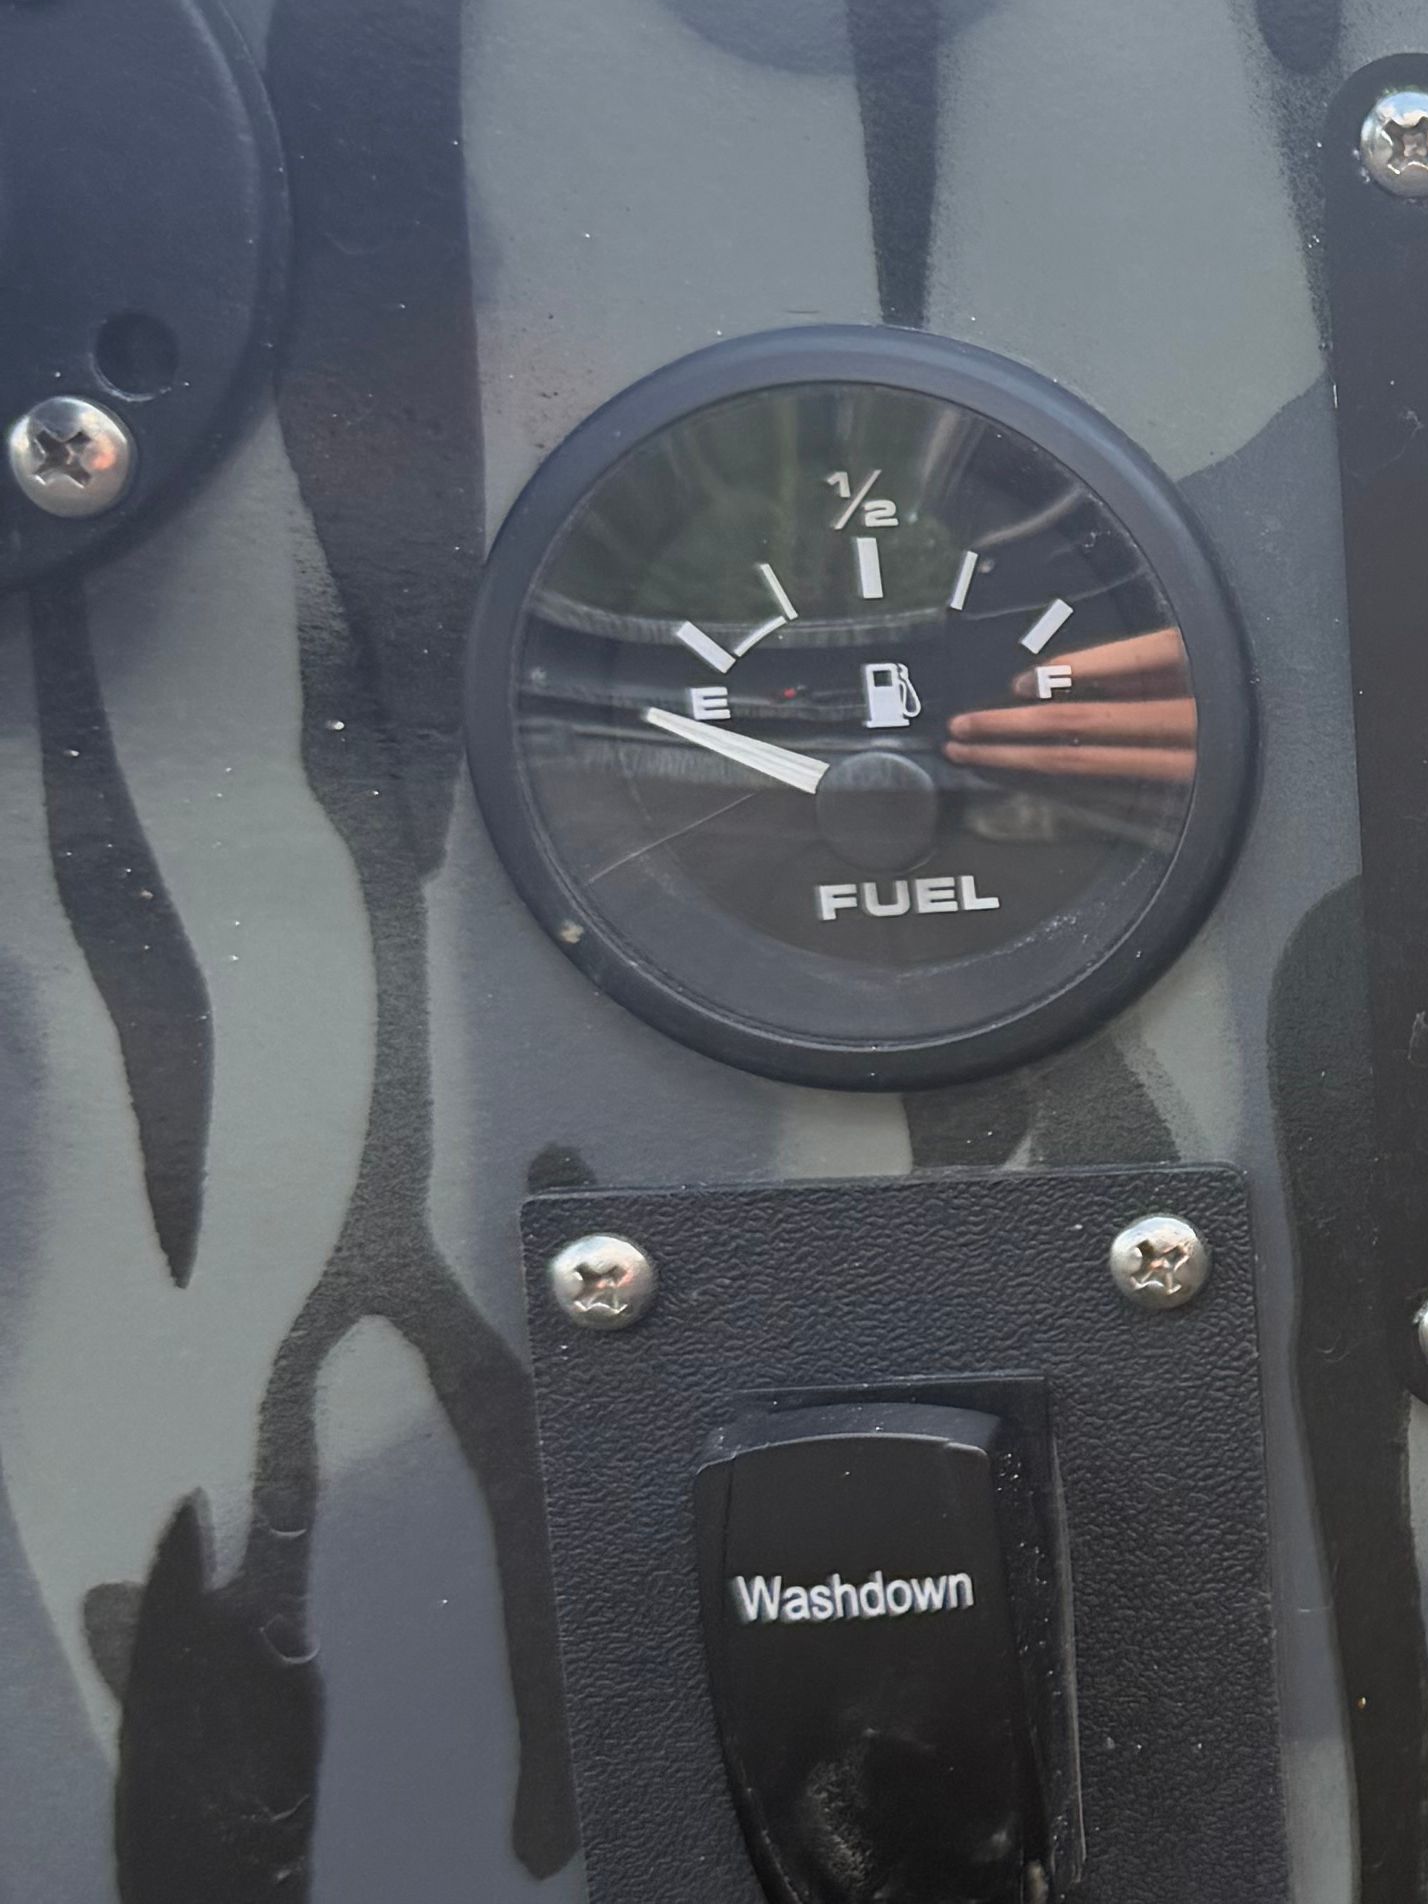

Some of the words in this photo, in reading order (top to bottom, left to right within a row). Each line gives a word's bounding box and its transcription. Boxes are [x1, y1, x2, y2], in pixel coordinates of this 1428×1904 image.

[1035, 664, 1073, 699] F
[689, 686, 732, 721] E
[818, 874, 1000, 921] FUEL
[733, 1566, 975, 1625] Washdown
